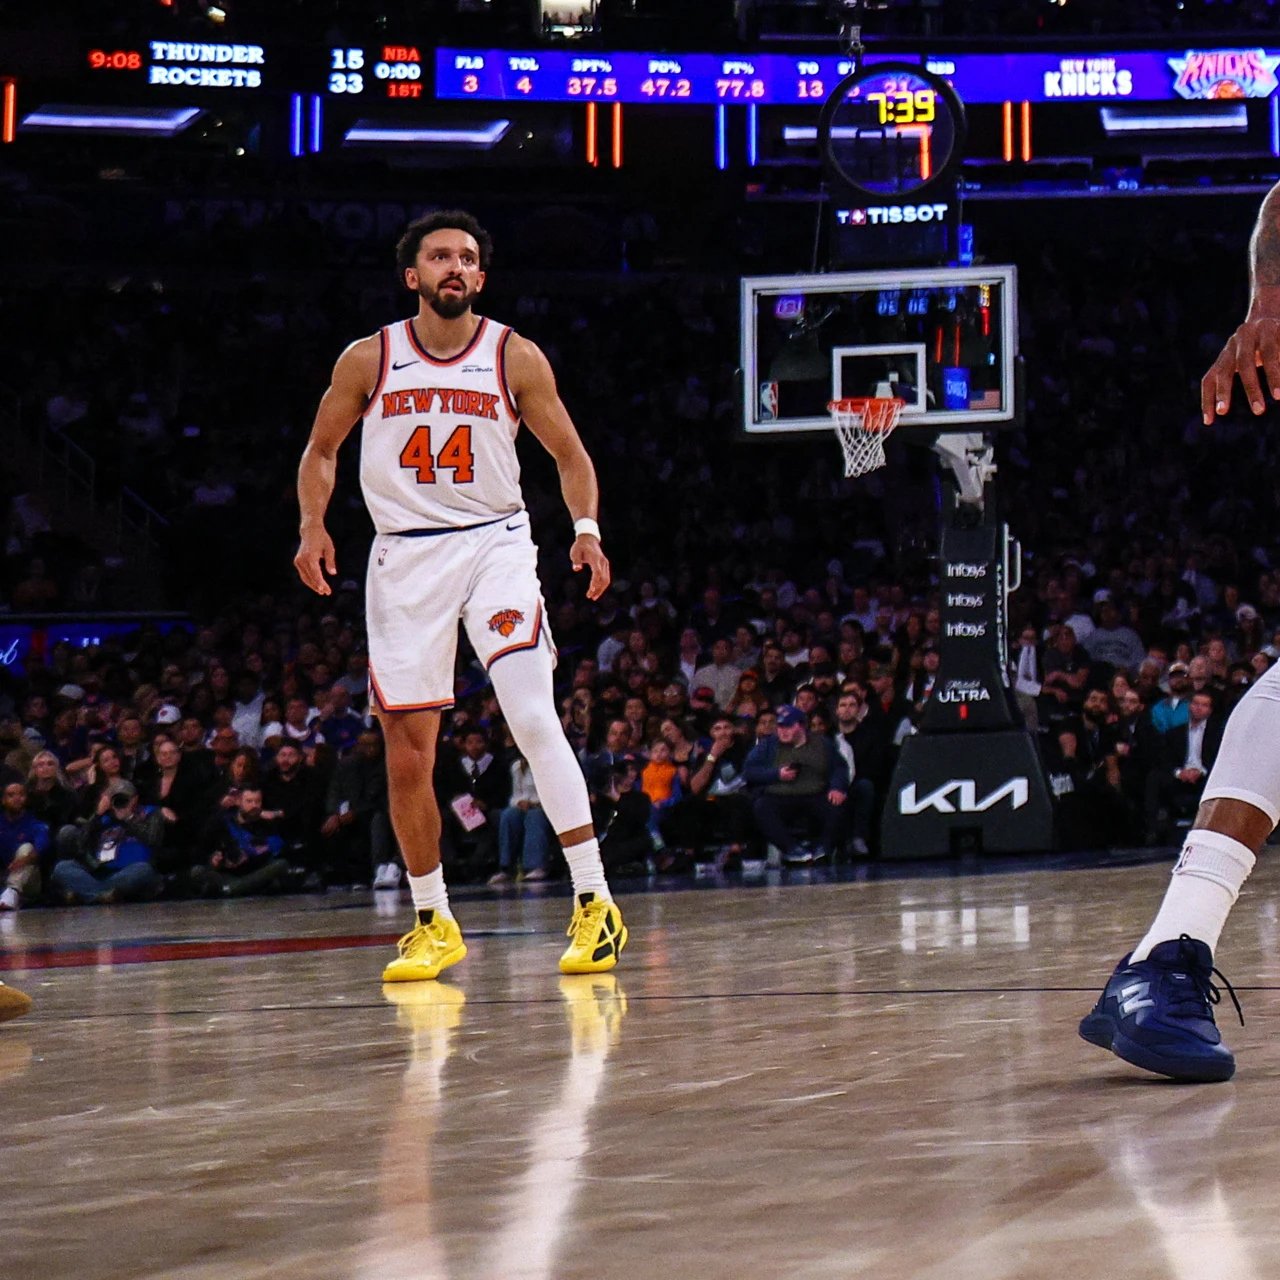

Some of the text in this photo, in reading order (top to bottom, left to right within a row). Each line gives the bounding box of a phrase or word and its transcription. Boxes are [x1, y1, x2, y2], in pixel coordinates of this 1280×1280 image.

[89, 49, 142, 69] 9:08
[151, 41, 265, 64] THUNDER
[330, 49, 364, 69] 15
[383, 45, 421, 61] NBA
[374, 63, 421, 80] 0:00
[509, 57, 539, 71] TOL
[797, 61, 819, 75] TO
[1060, 58, 1116, 72] NEW YORK
[1177, 50, 1269, 88] KNICKS
[150, 65, 261, 87] ROCKETS
[329, 73, 364, 94] 33
[463, 75, 478, 93] 3
[516, 76, 532, 94] 4
[1044, 70, 1133, 96] KNICKS
[387, 83, 422, 98] 1ST
[567, 77, 617, 96] 37.5
[641, 78, 691, 97] 47.2
[715, 80, 765, 98] 77.8
[797, 80, 824, 98] 13
[867, 90, 936, 125] 7:39
[868, 204, 948, 225] TISSOT
[382, 387, 500, 420] NEW YORK
[399, 425, 474, 484] 44
[947, 563, 988, 580] Infosys
[947, 592, 984, 608] Infosys
[946, 622, 987, 638] Infosys
[938, 687, 991, 703] ULTRA
